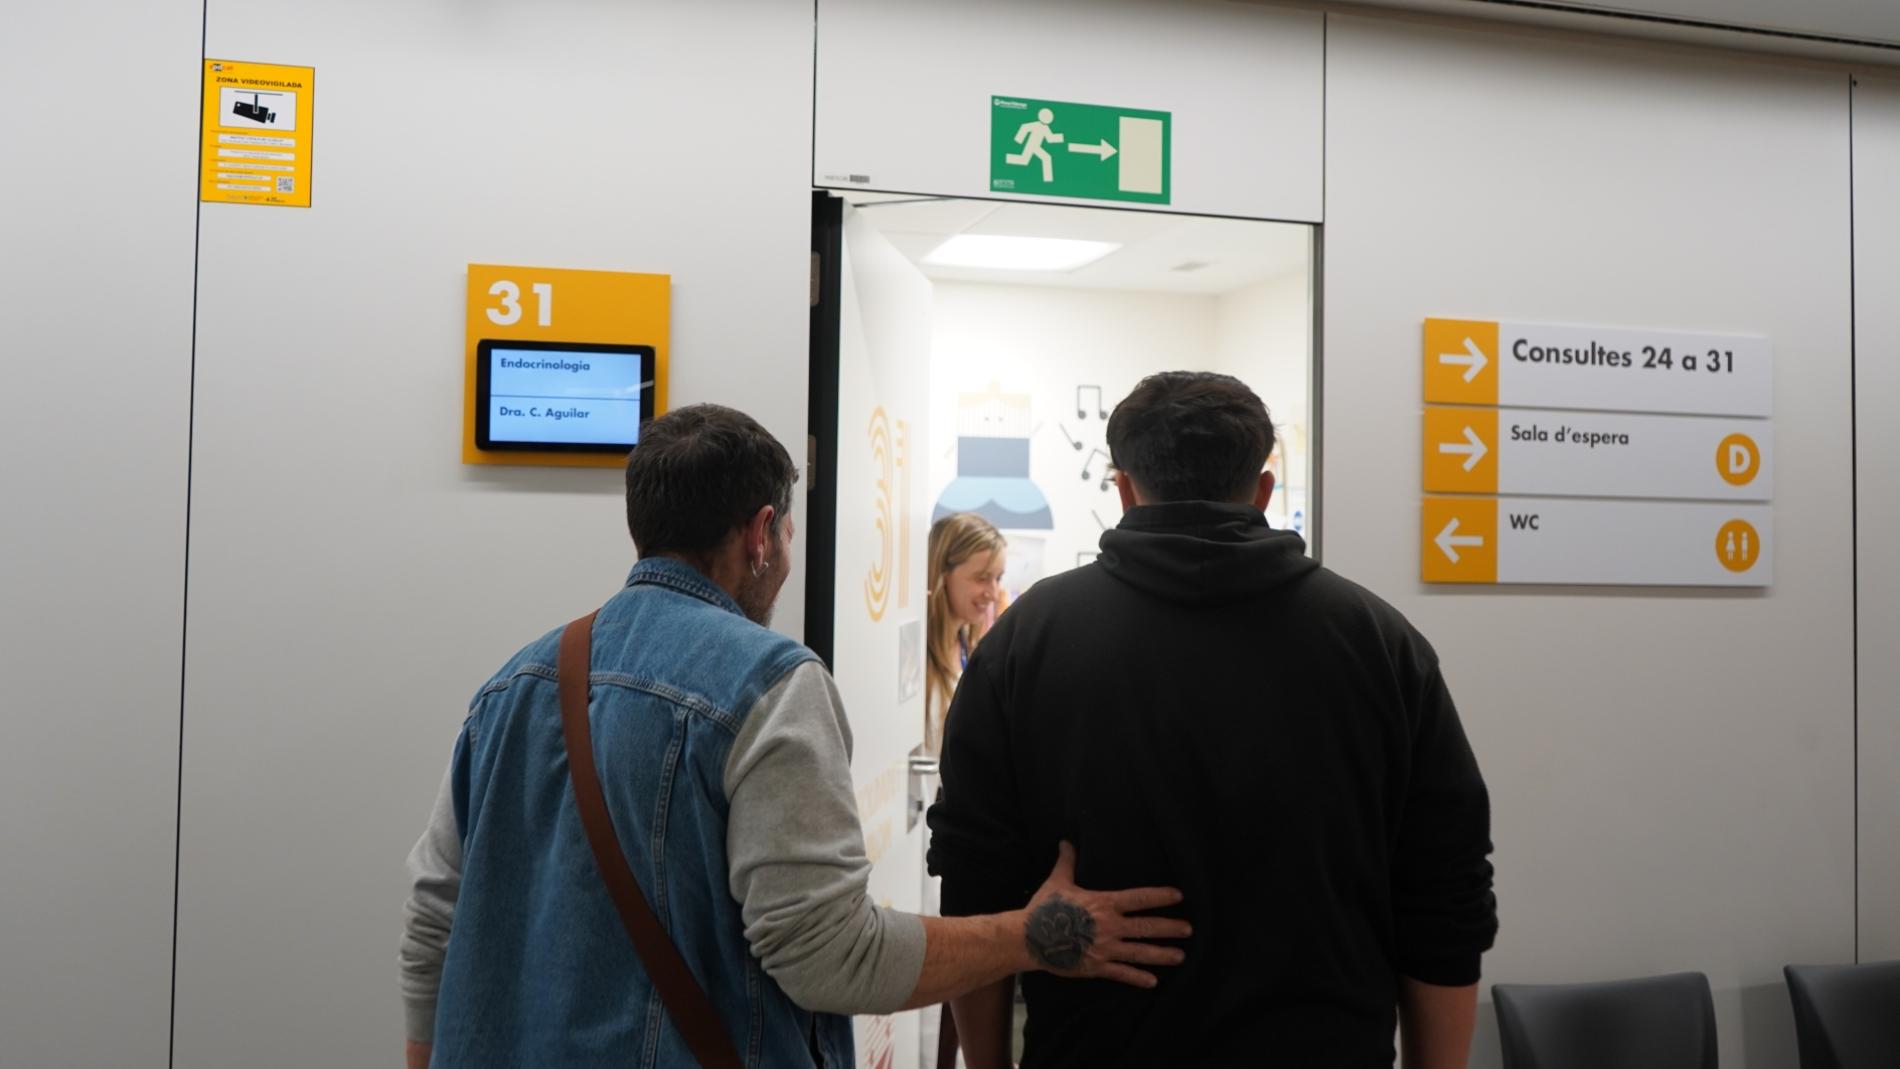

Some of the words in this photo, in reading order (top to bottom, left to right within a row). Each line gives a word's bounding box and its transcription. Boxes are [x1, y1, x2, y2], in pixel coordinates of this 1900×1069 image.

[216, 76, 239, 84] ZONA
[241, 78, 302, 89] VIDEOVIGILADA
[486, 279, 552, 326] 31
[1513, 339, 1633, 368] Consultes
[1642, 346, 1673, 370] 24
[1682, 355, 1697, 371] a
[1706, 350, 1734, 373] 31
[500, 358, 590, 373] Endocrinologia
[500, 406, 525, 417] Dra.
[530, 407, 541, 418] C.
[546, 408, 589, 420] Aguilar
[1511, 425, 1548, 442] Sala
[1728, 444, 1751, 474] D
[1509, 513, 1539, 531] WC
